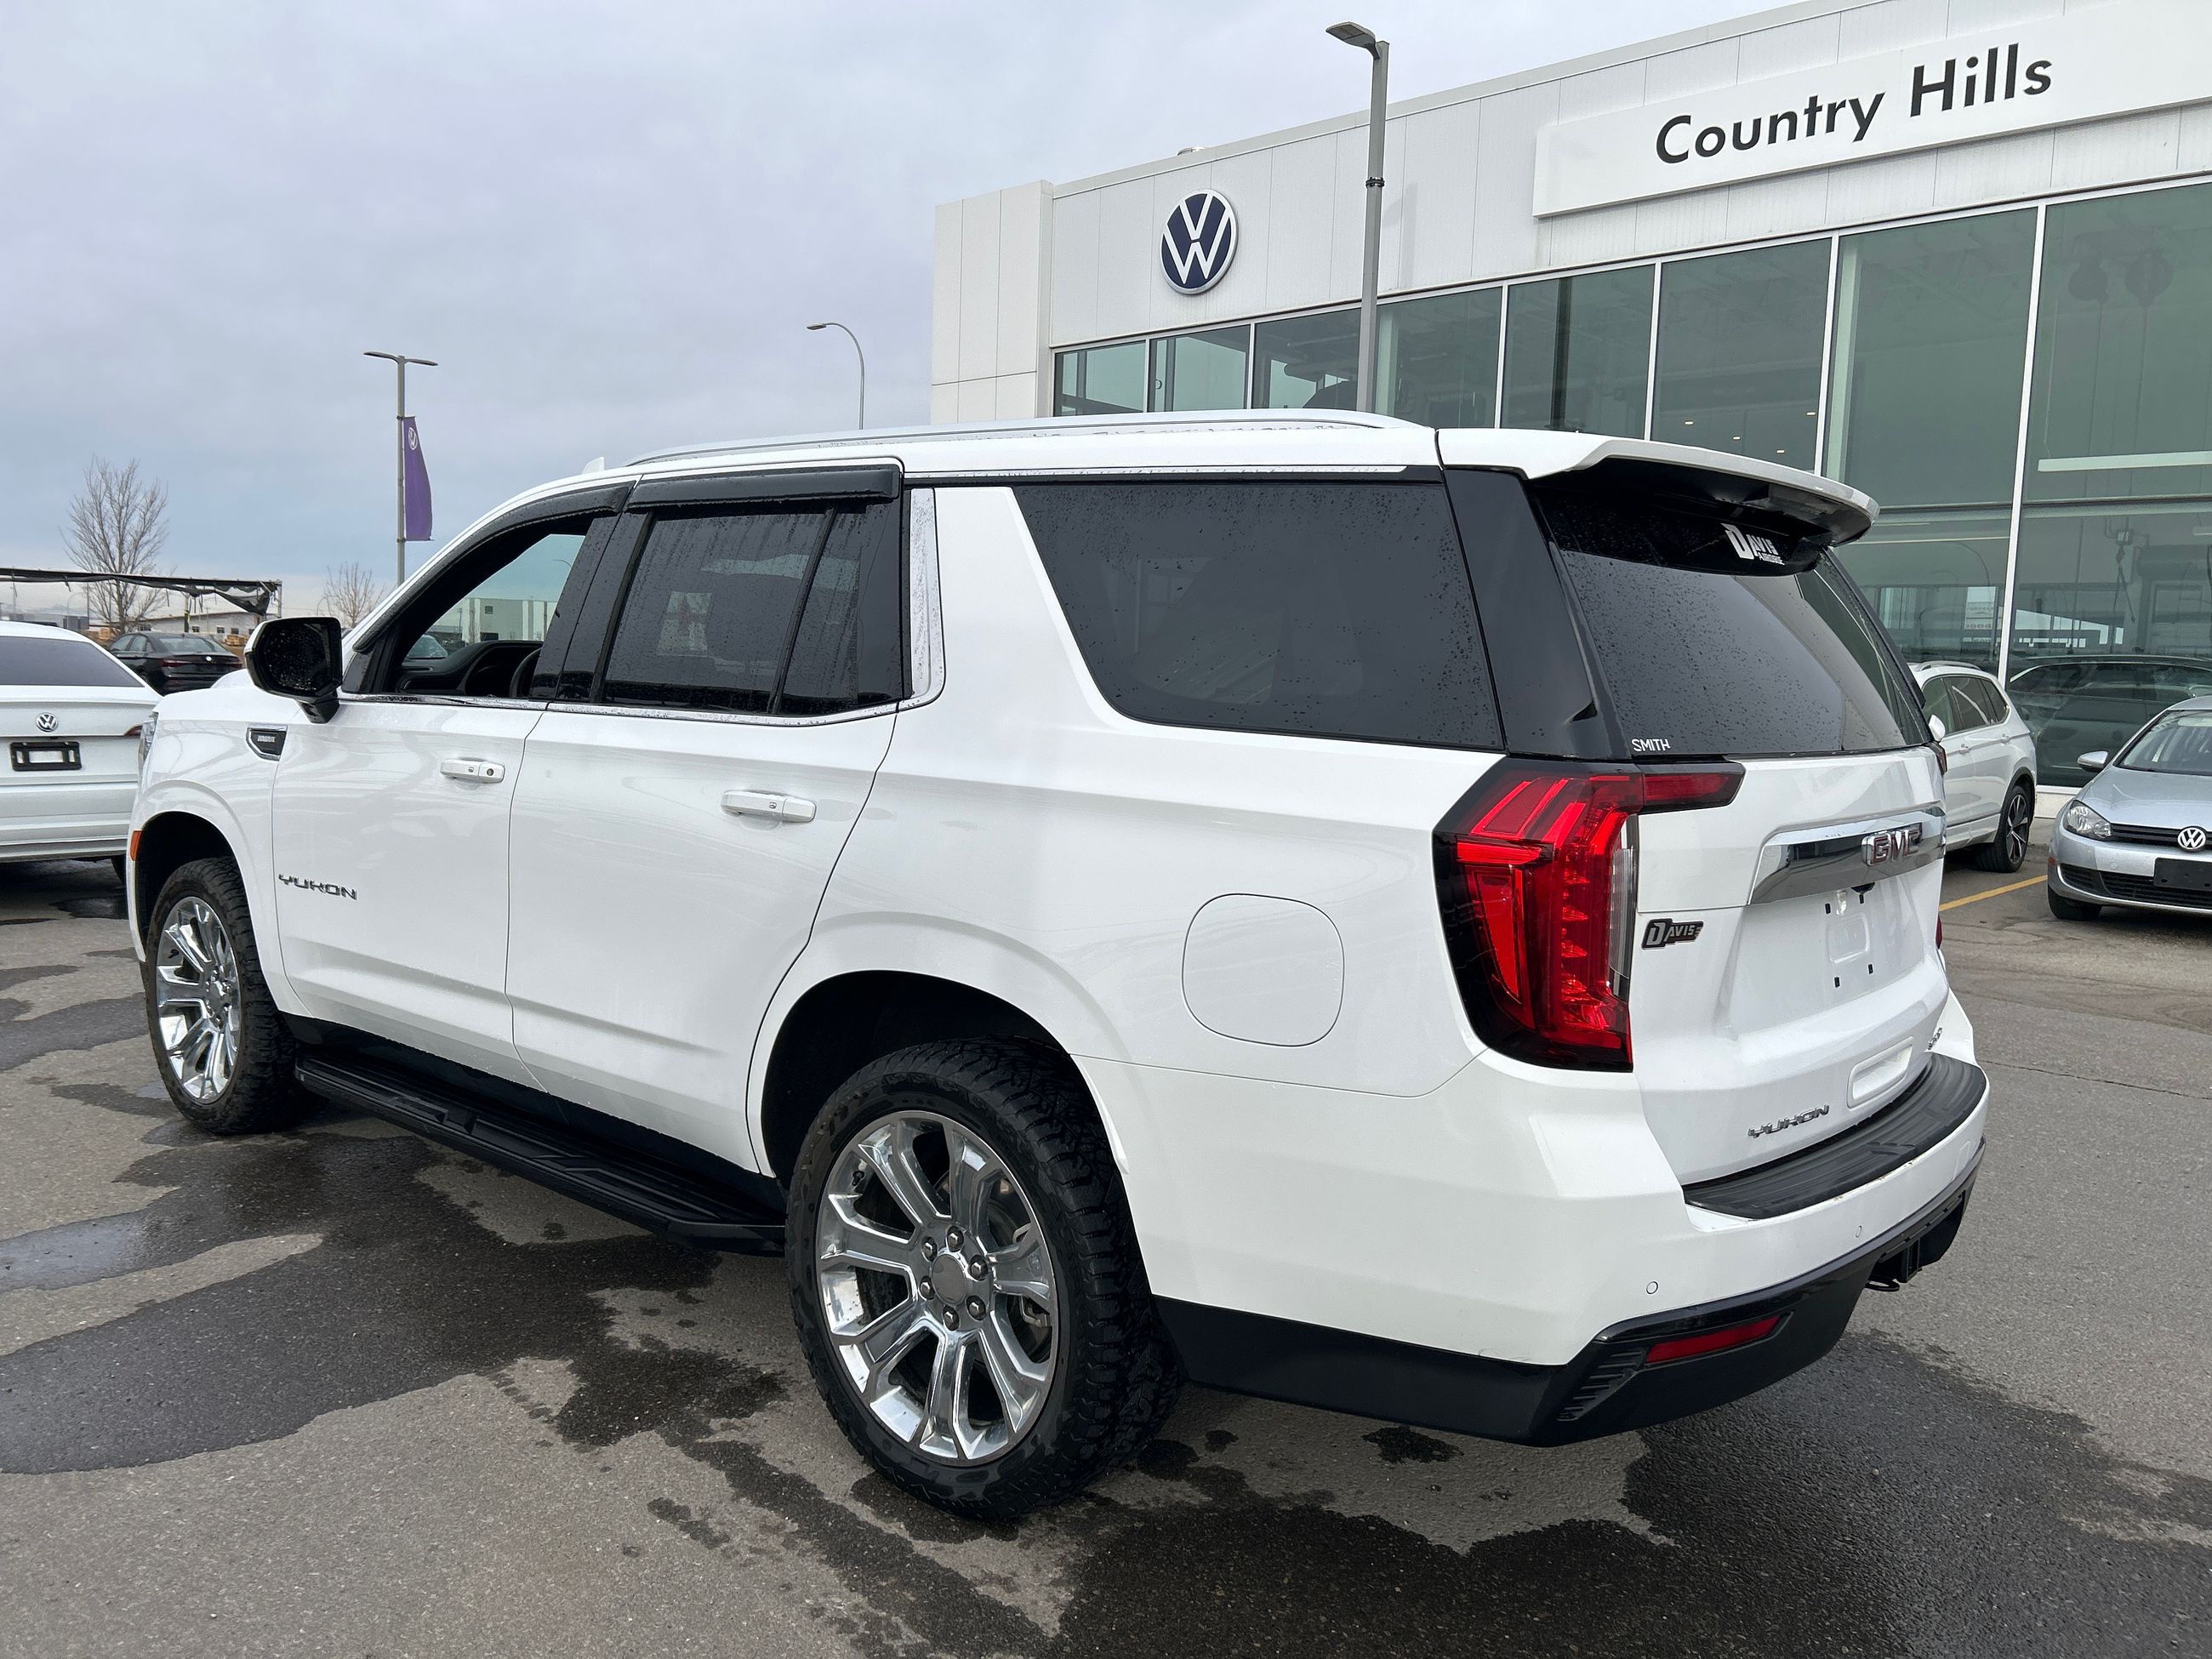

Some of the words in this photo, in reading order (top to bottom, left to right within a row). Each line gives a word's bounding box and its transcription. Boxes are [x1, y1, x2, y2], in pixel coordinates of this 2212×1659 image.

[1656, 91, 1886, 164] Country
[1910, 43, 2052, 118] Hills
[1161, 190, 1236, 288] VW
[36, 712, 58, 732] VW
[1631, 738, 1671, 752] SMITH
[1866, 829, 1921, 865] GMC
[2178, 827, 2206, 849] VW
[278, 874, 357, 900] YUKON
[1645, 921, 1696, 946] DAVIS
[1748, 1104, 1830, 1138] YUKON
